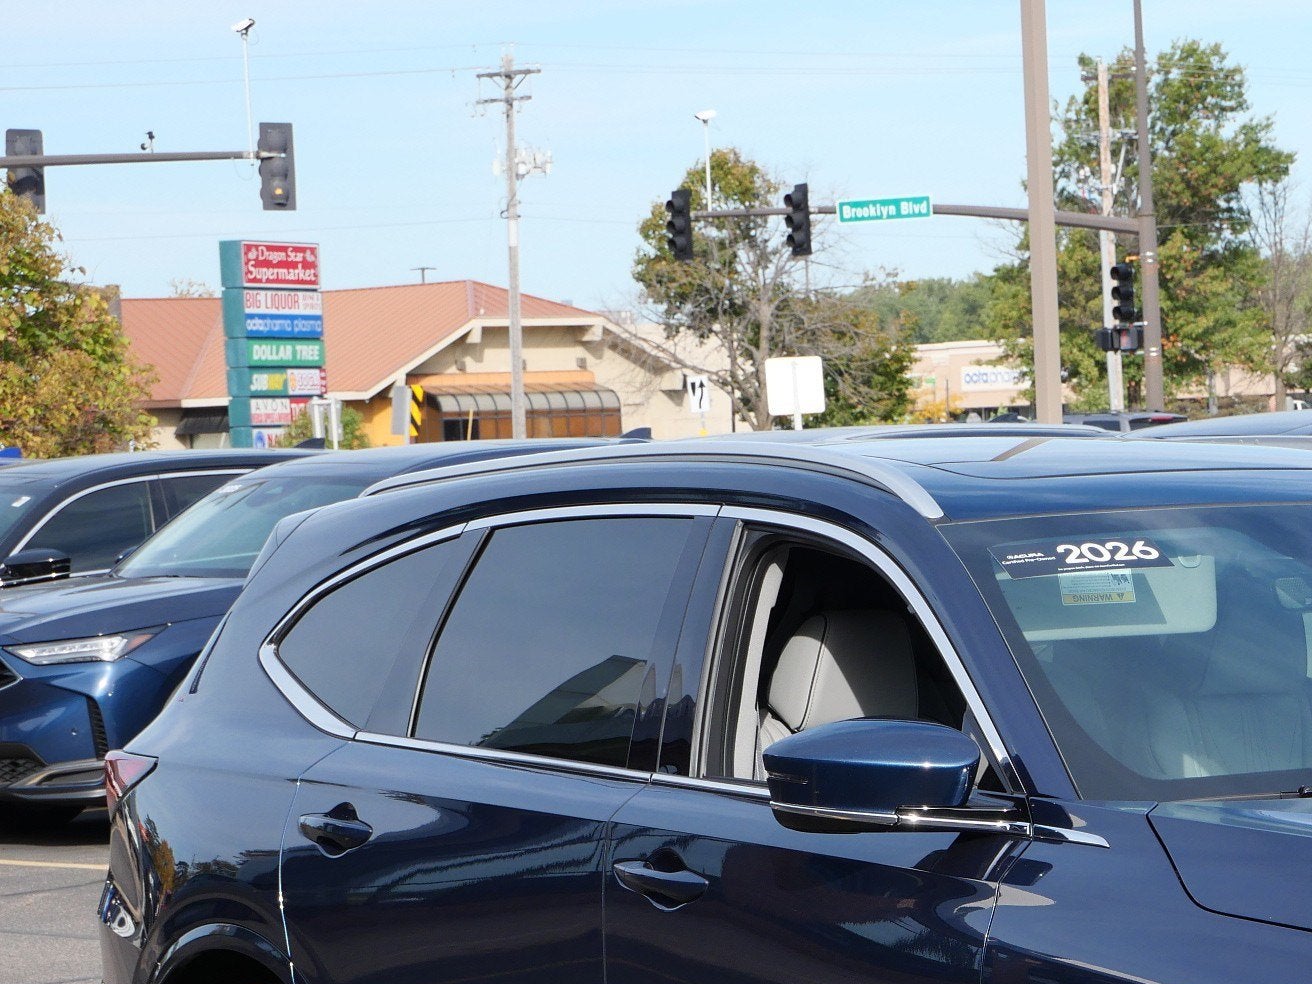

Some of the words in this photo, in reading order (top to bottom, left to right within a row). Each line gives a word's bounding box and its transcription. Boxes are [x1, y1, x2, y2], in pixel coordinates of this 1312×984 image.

[842, 204, 896, 219] Brooklyn
[900, 201, 928, 215] Blvd
[258, 246, 286, 263] Dragon
[287, 247, 304, 262] Star
[247, 260, 316, 283] Supermarket
[245, 292, 262, 309] BIG
[265, 293, 299, 311] LIQUOR
[293, 318, 322, 334] plasma
[253, 345, 292, 360] DOLLAR
[296, 345, 320, 361] TREE
[255, 400, 288, 411] AVON
[1013, 552, 1045, 560] ACURA
[1056, 541, 1159, 564] 2026
[1072, 593, 1113, 603] WARNING
